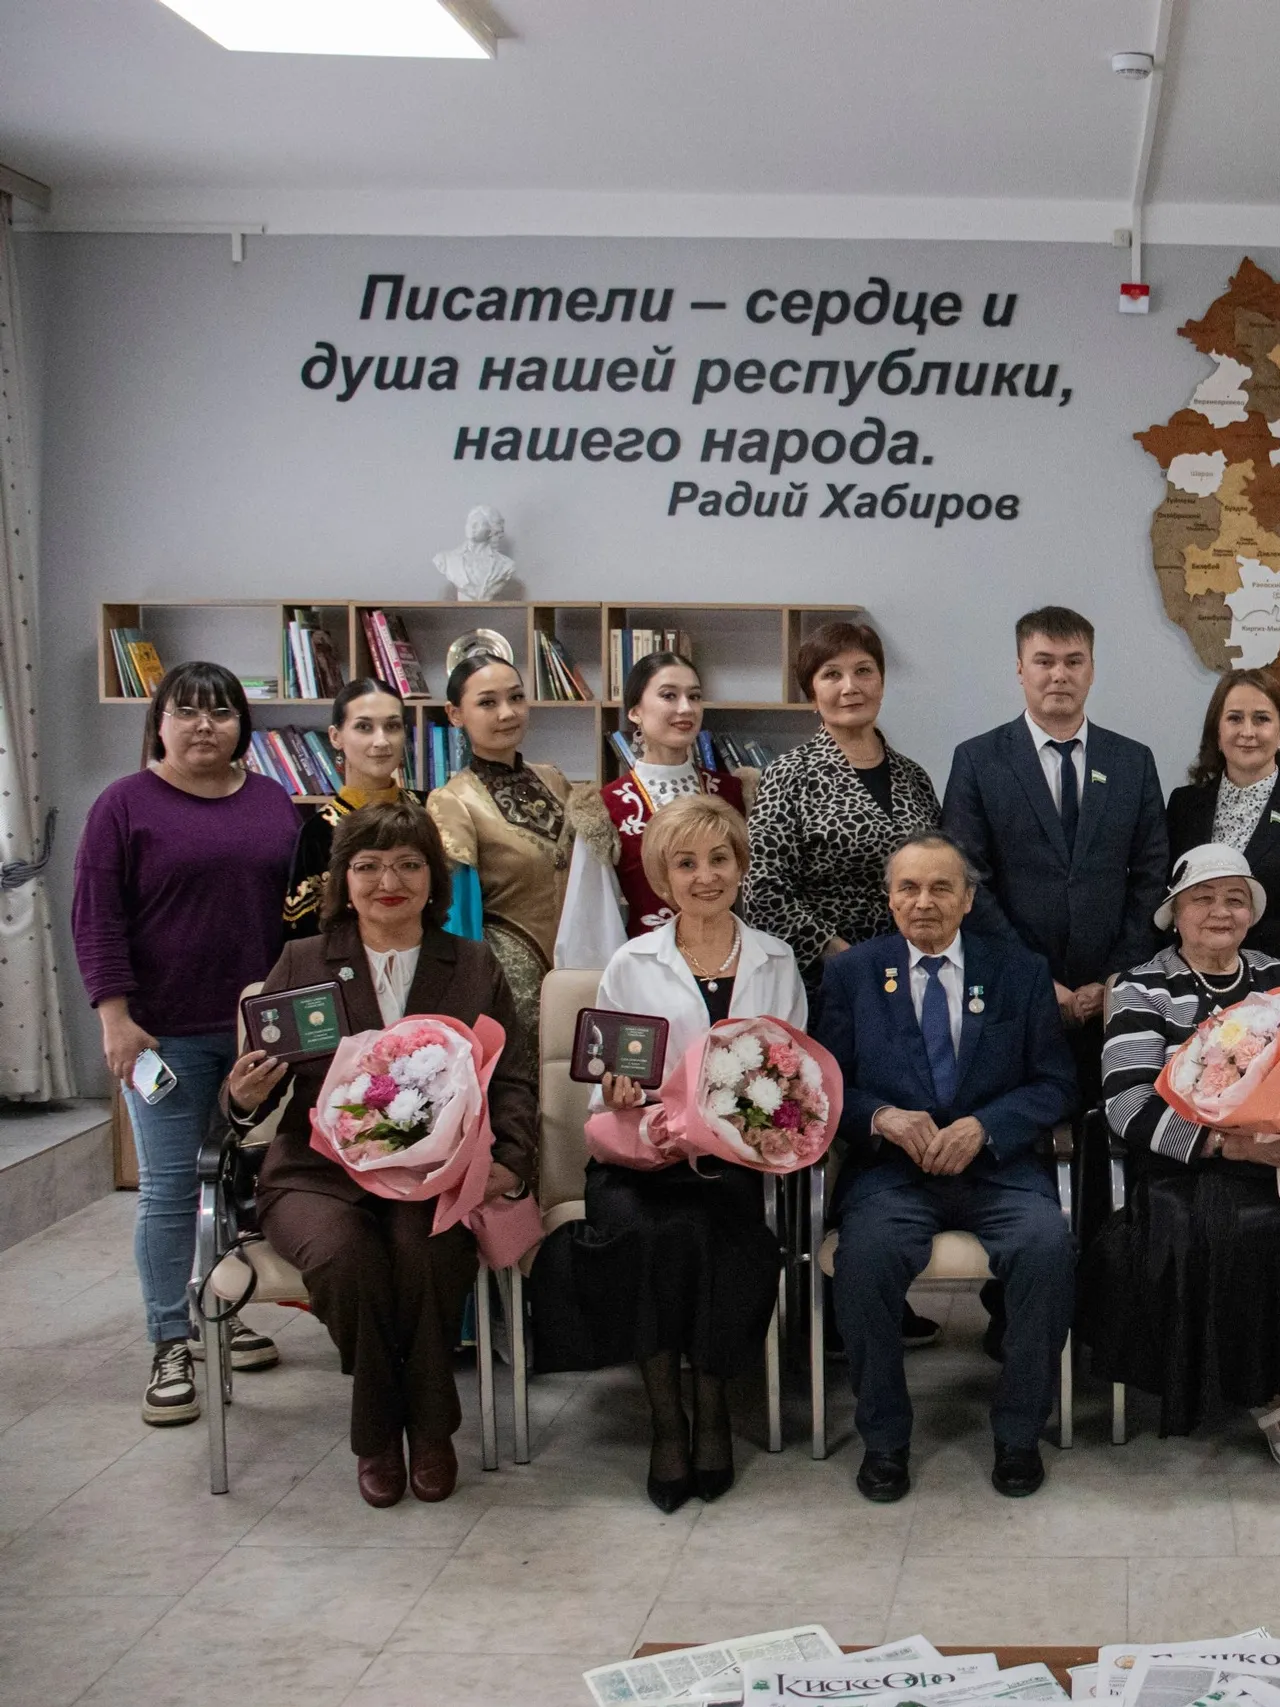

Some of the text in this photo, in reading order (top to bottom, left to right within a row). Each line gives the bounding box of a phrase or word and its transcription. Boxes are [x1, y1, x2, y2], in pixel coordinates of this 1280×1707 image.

[360, 275, 674, 322] Писатели
[746, 277, 962, 336] сердце
[983, 293, 1017, 327] и
[301, 342, 1073, 407] душа нашей республики,
[454, 417, 934, 475] нашего народа.
[667, 481, 1020, 529] Радий Хабиров
